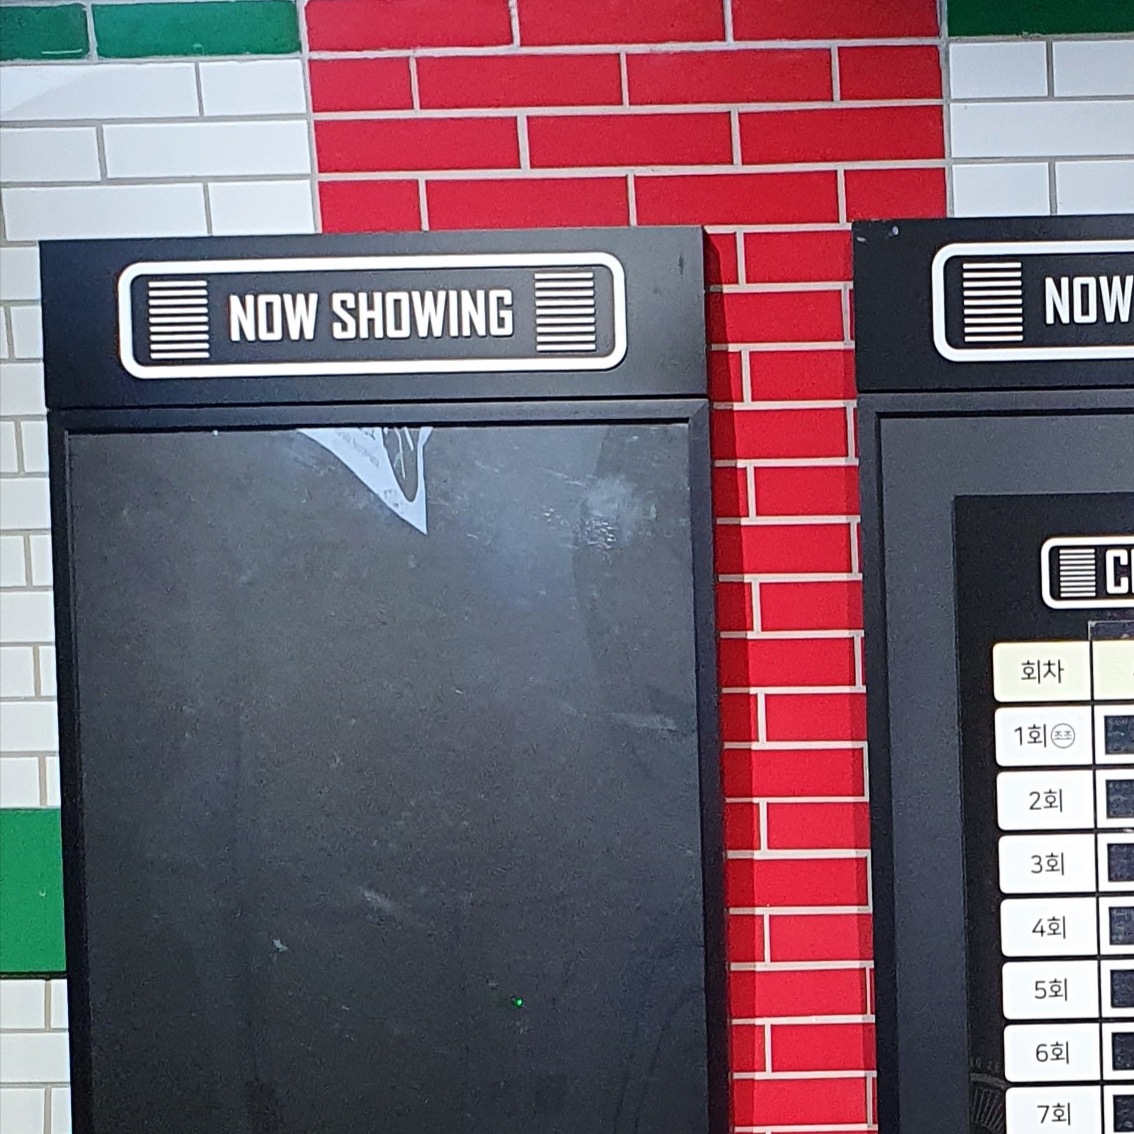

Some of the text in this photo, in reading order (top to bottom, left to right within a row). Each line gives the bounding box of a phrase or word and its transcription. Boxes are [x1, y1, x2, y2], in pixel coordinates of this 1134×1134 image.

[1045, 274, 1134, 325] NOW
[229, 289, 515, 342] NOW SHOWING
[1020, 658, 1066, 685] 회차
[1029, 788, 1064, 813] 2회
[1031, 852, 1065, 876] 3회
[1031, 915, 1067, 940] 4회
[1034, 977, 1069, 1002] 5회
[1035, 1040, 1070, 1065] 6회
[1036, 1102, 1072, 1127] 7회
